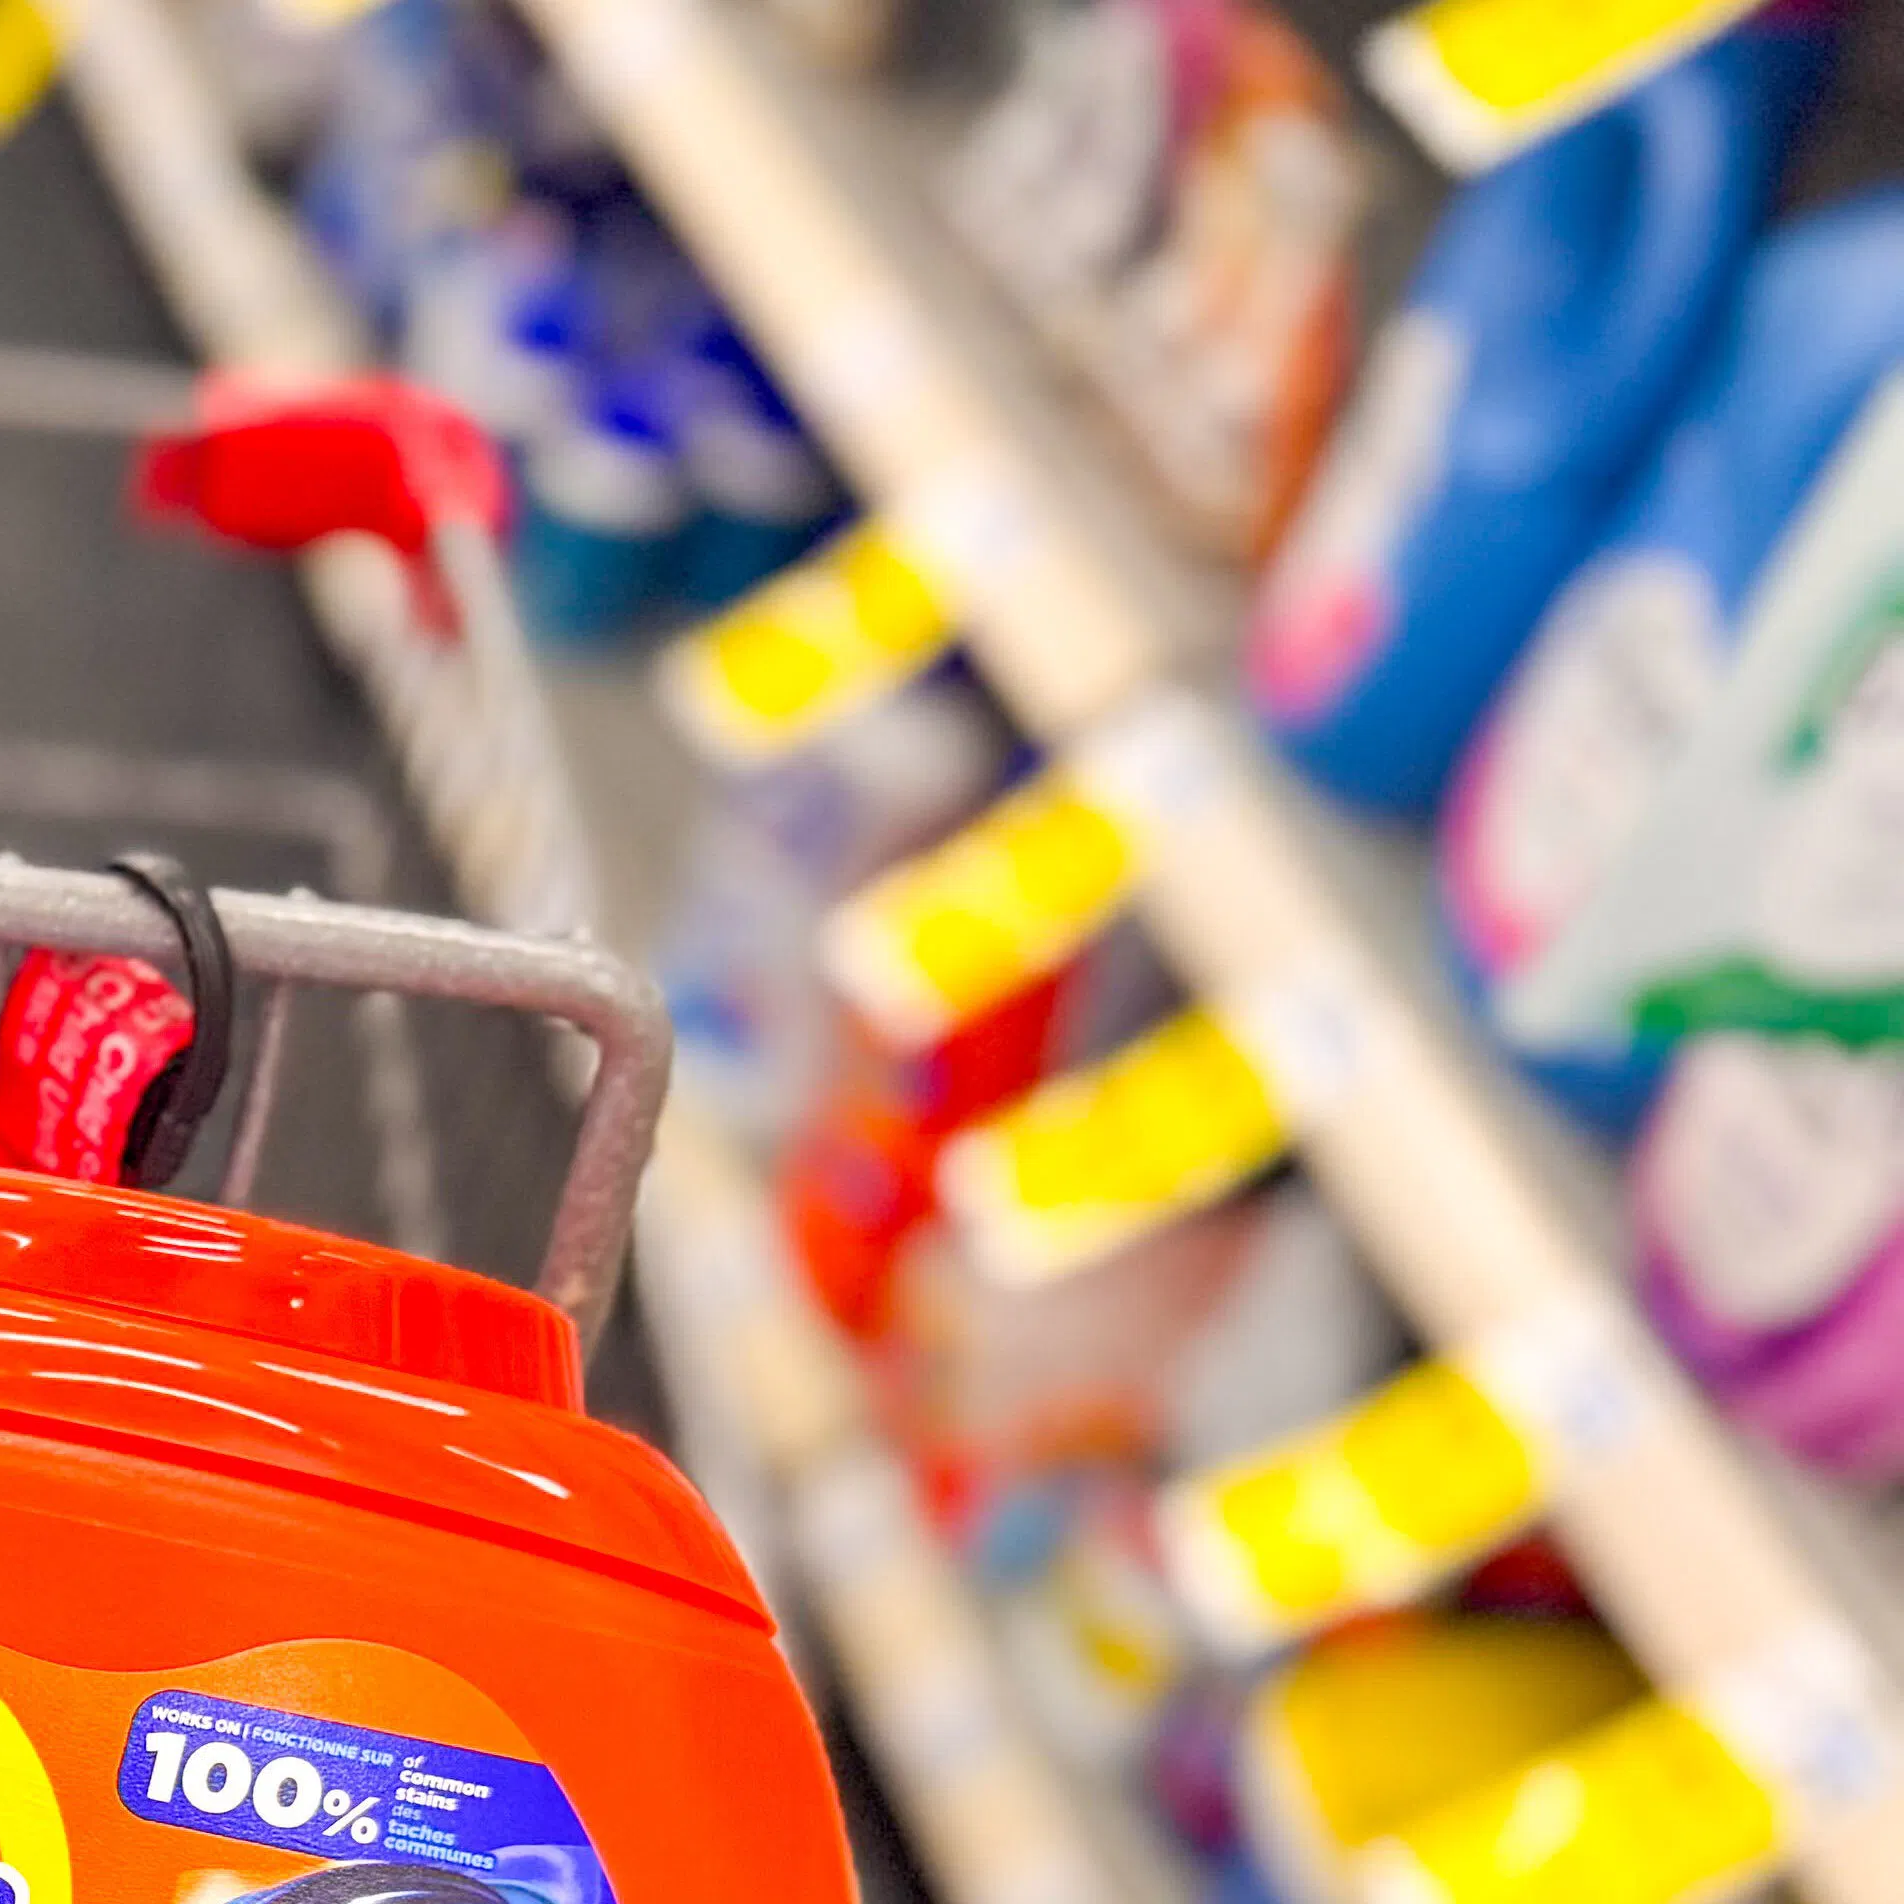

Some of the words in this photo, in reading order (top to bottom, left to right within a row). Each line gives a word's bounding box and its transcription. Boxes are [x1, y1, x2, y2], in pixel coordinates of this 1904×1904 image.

[151, 1704, 213, 1731] WORKS
[214, 1718, 242, 1737] ON
[252, 1726, 359, 1761] FONCTIONNE
[360, 1747, 394, 1768] SUR
[403, 1753, 424, 1771] of
[145, 1731, 381, 1845] 100%
[394, 1786, 458, 1812] stains
[398, 1769, 491, 1800] common
[392, 1803, 422, 1821] des
[388, 1818, 456, 1847] taches
[383, 1835, 495, 1871] communes
